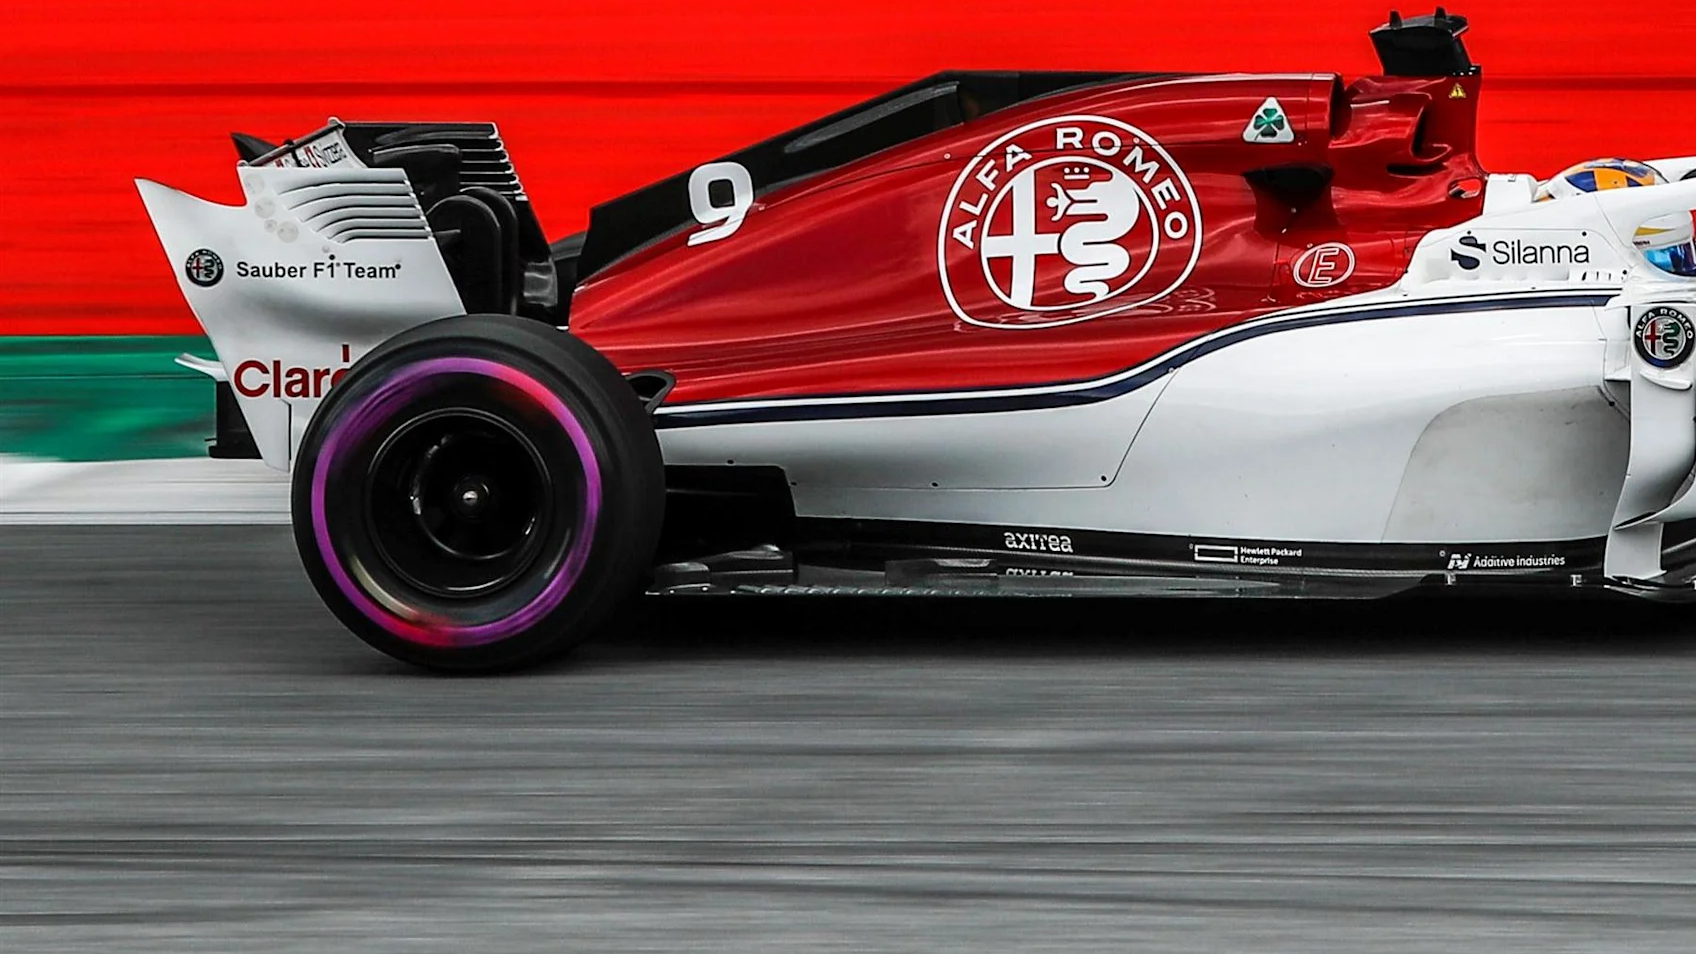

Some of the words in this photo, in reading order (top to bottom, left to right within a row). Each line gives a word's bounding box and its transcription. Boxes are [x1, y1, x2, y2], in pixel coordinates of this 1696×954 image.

[953, 143, 1033, 249] ALFA
[1056, 127, 1189, 240] ROMEO
[687, 161, 754, 247] 9
[1493, 239, 1590, 265] Silanna
[236, 261, 307, 279] Sauber
[343, 262, 397, 279] Team
[1635, 311, 1656, 338] ALFA
[1660, 308, 1694, 339] ROMEO
[233, 359, 352, 398] Clar
[1240, 546, 1270, 556] Hewlett
[1271, 548, 1302, 557] Packard
[1240, 555, 1279, 566] Enterprise
[1473, 555, 1515, 568] Additive
